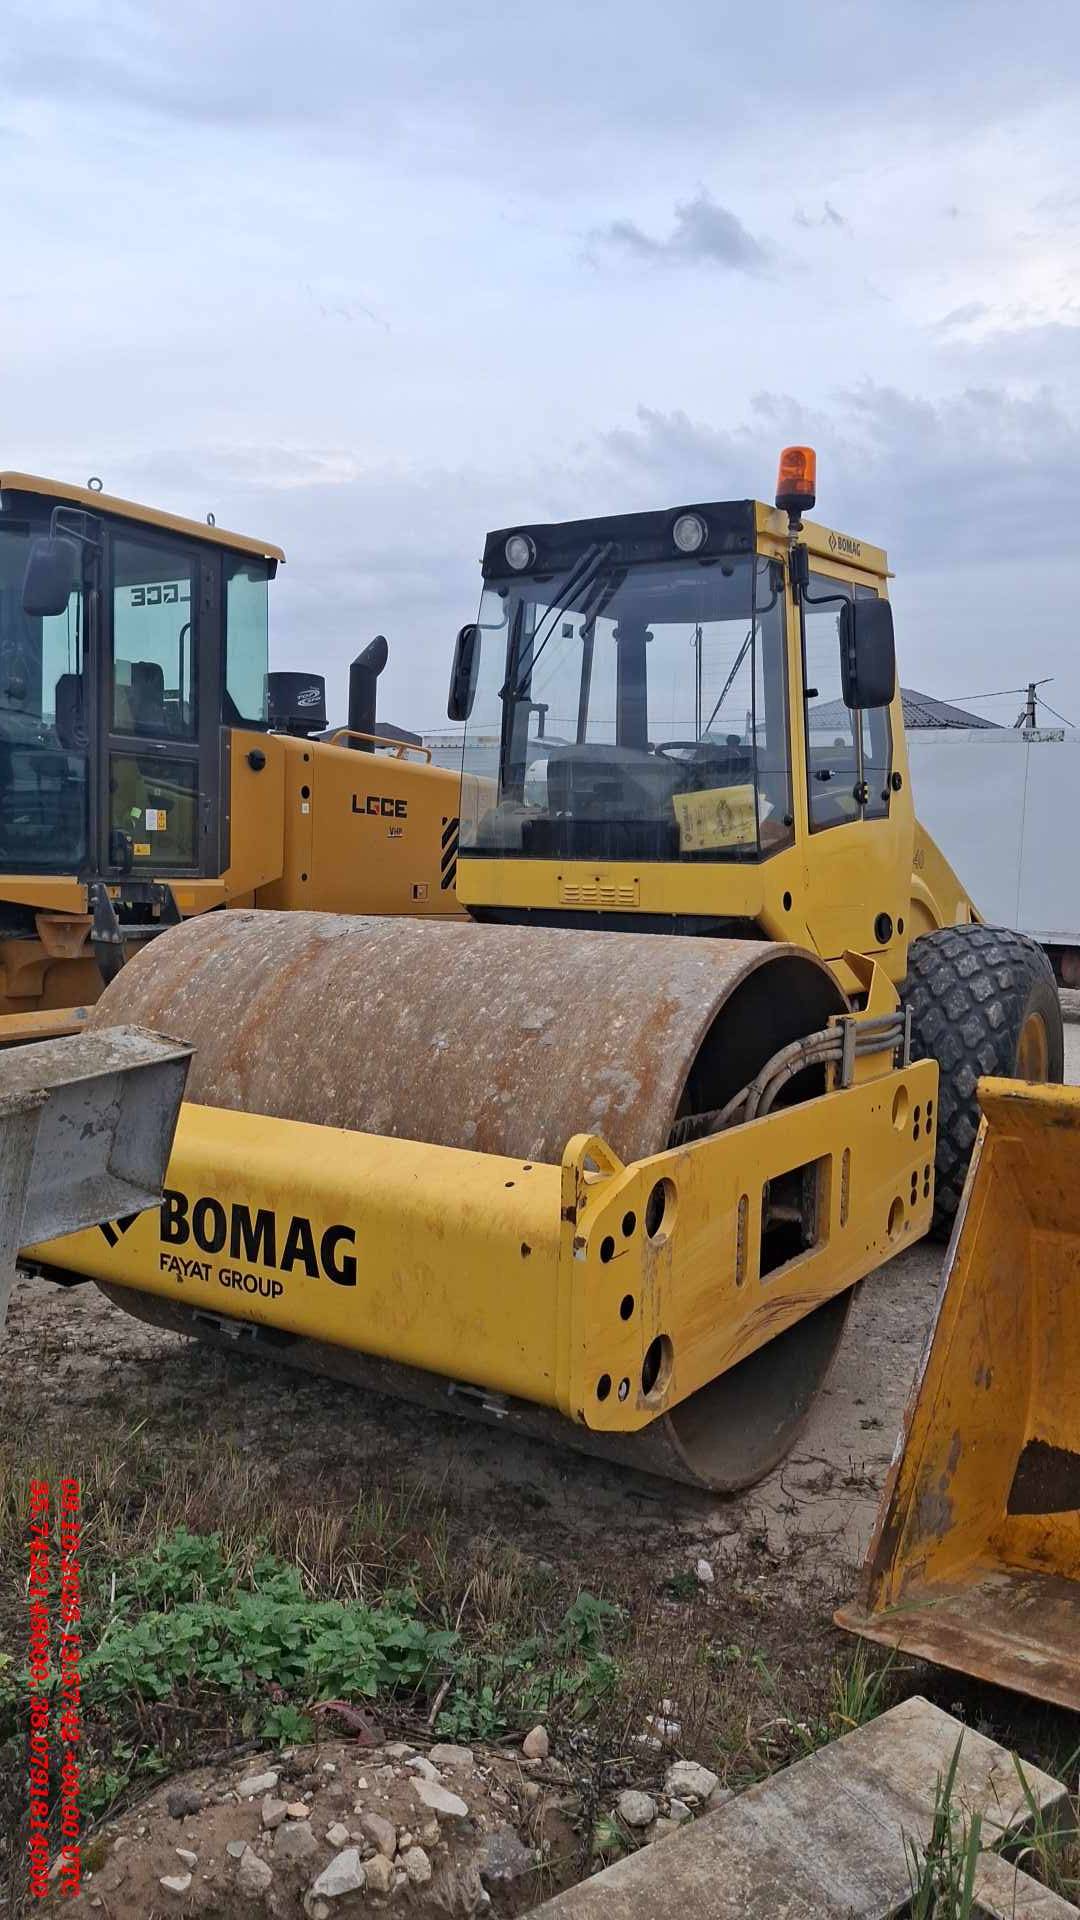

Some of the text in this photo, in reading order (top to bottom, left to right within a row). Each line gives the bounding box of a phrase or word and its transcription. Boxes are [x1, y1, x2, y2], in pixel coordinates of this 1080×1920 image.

[838, 536, 861, 557] BOMAG
[160, 1189, 357, 1286] BOMAG
[160, 1253, 284, 1298] FAYAT GROUP
